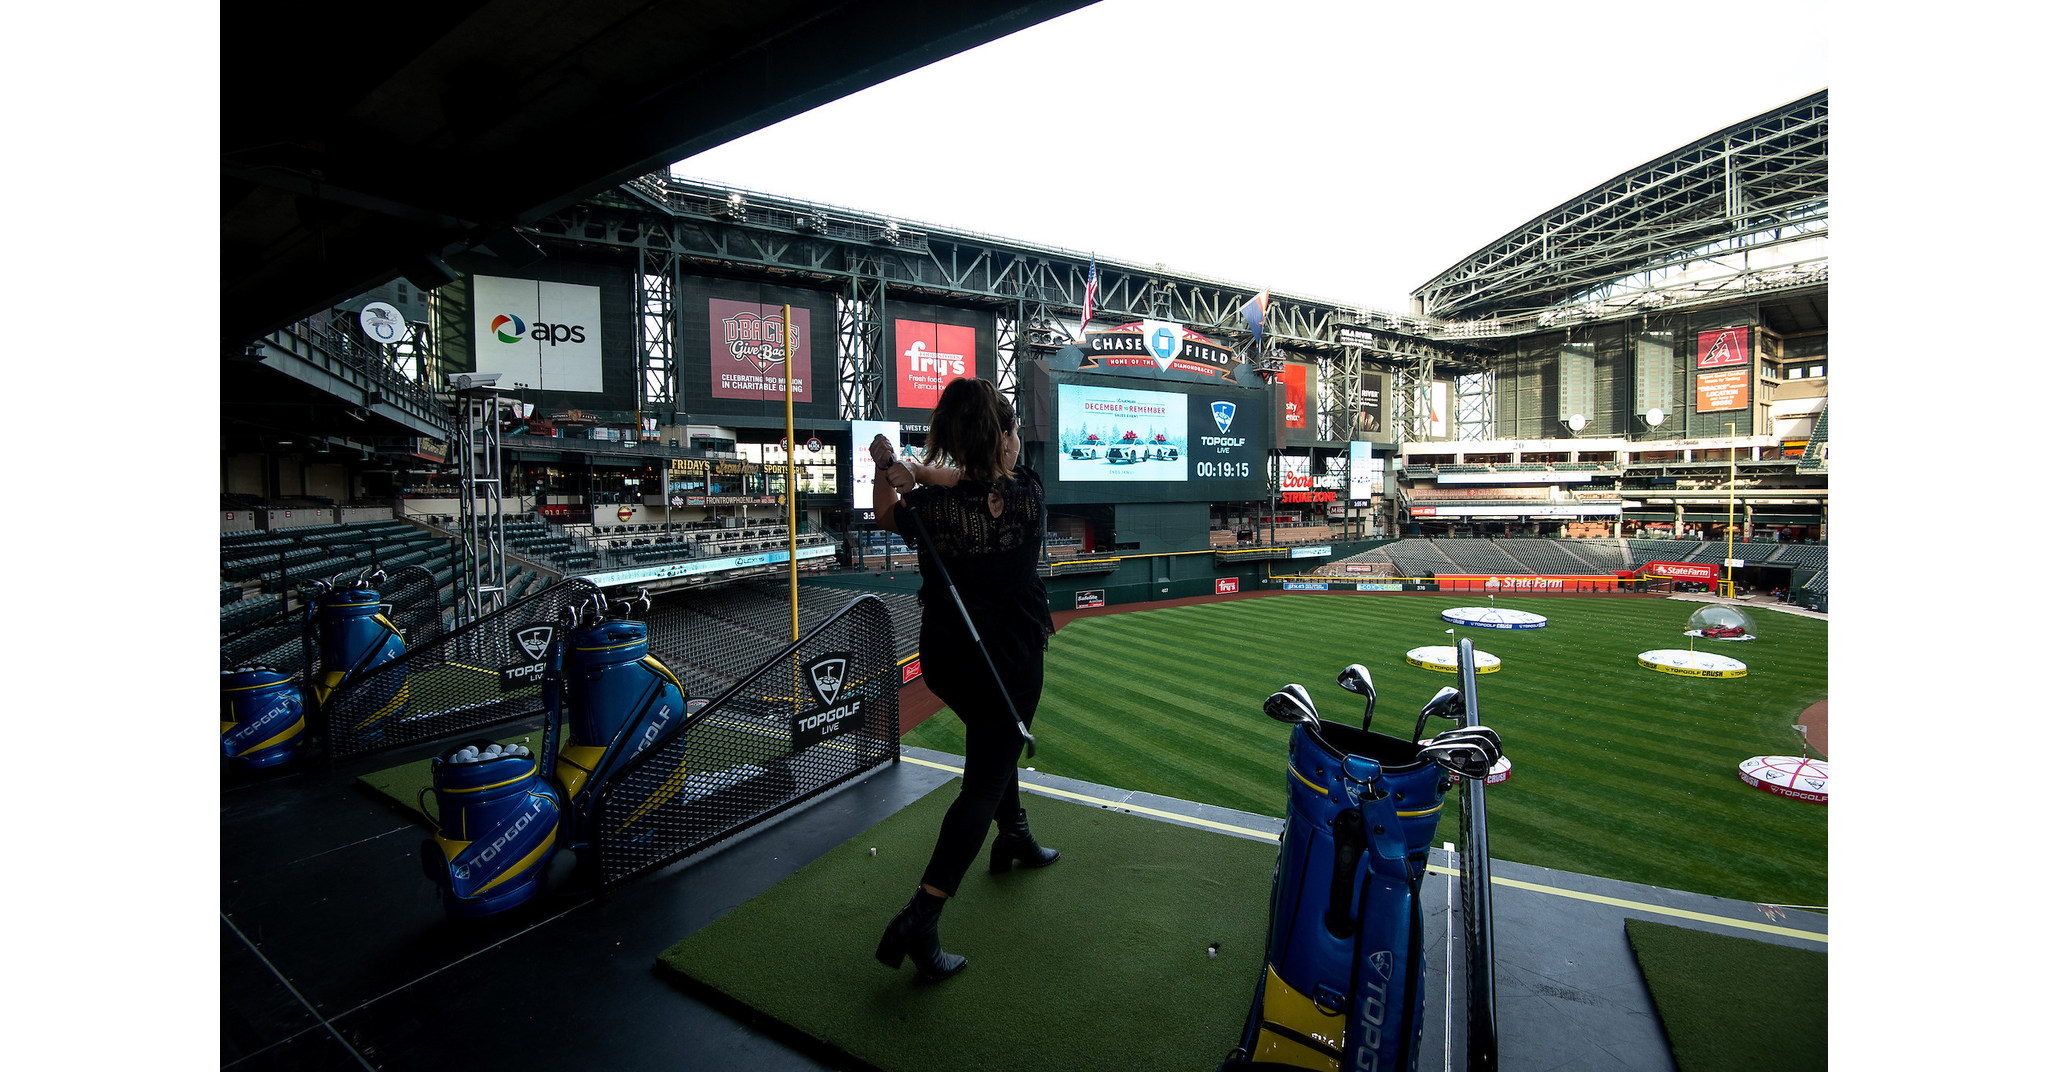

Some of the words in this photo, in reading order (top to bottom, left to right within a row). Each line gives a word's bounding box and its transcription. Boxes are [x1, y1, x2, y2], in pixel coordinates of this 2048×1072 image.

[531, 322, 586, 347] aps
[730, 340, 760, 359] Give
[1092, 337, 1142, 351] CHASE
[1185, 344, 1229, 365] FIELD
[903, 340, 966, 376] fry's
[1173, 362, 1214, 375] DIAMONDBACKS
[721, 373, 764, 384] CELEBRATING
[778, 377, 803, 387] MIION
[908, 374, 926, 382] Fresh
[927, 375, 944, 384] food.
[721, 380, 731, 389] IN
[732, 381, 777, 392] CHARITABLE
[913, 381, 938, 391] Famous
[1084, 402, 1123, 412] DECEMBER
[1129, 405, 1166, 414] REMEMBER
[1285, 402, 1297, 412] sity
[905, 424, 922, 432] WEST
[1201, 436, 1246, 447] TOPGOLF
[671, 458, 711, 471] FRIDAY'S
[763, 464, 789, 474] SPORTS
[1196, 462, 1250, 478] 00:19:15
[1283, 471, 1314, 488] Coors
[1282, 491, 1313, 503] STRIKE
[1313, 491, 1337, 502] ZONE
[863, 512, 876, 520] 3:5
[1668, 566, 1689, 575] State
[1689, 567, 1709, 576] Farm
[1219, 580, 1236, 592] fry's
[1504, 576, 1533, 588] State
[1534, 577, 1563, 588] Farm
[505, 662, 548, 679] TOPG
[1702, 670, 1724, 678] CRUSH
[530, 673, 544, 682] LIV
[235, 698, 291, 739] TOPGOLF
[799, 701, 861, 732] TOPGOLF
[822, 721, 840, 735] LIVE
[1487, 772, 1507, 784] CRUSH
[1779, 788, 1828, 802] TOPGOLF
[469, 797, 544, 868] TOPGOLF
[1356, 981, 1387, 1072] TOPG
